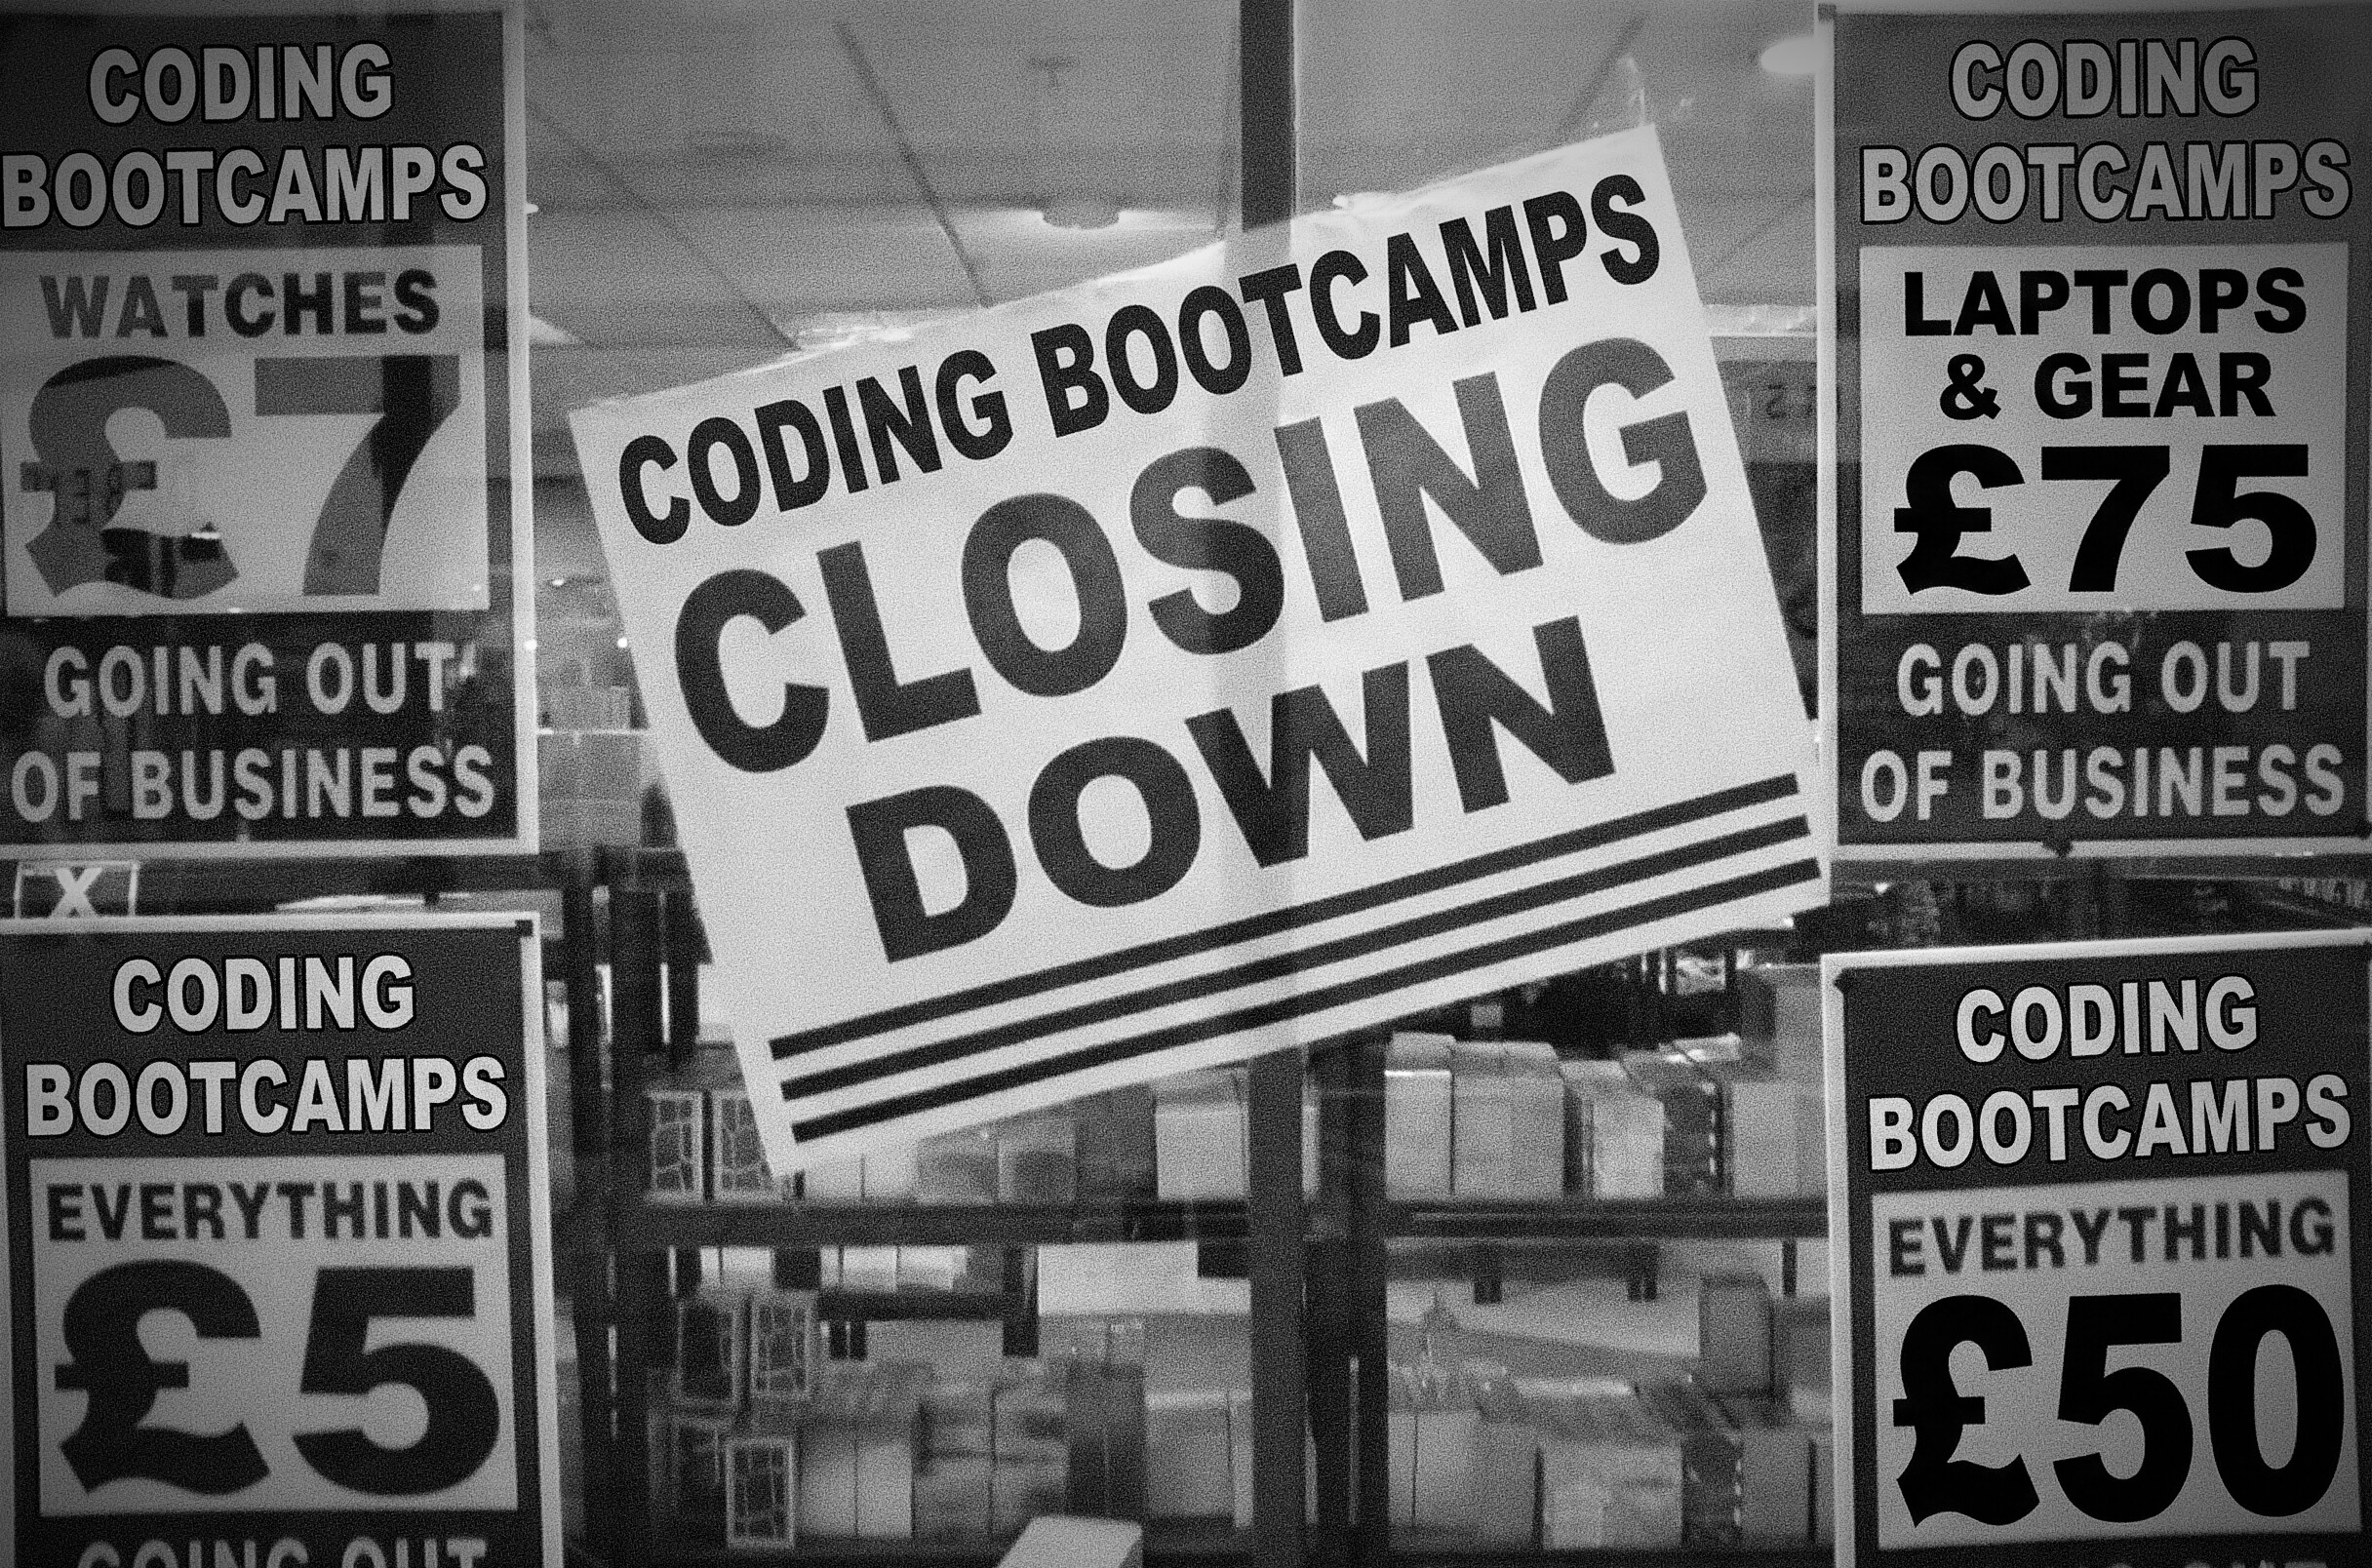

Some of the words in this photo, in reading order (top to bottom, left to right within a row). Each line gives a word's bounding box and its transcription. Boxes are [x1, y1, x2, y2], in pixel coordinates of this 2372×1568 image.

[91, 43, 392, 123] CODING
[1952, 40, 2255, 118] CODING
[3, 144, 487, 227] BOOTCAMPS
[1863, 143, 2348, 222] BOOTCAMPS
[39, 268, 440, 338] WATCHES
[1904, 266, 2308, 336] LAPTOPS
[618, 350, 1013, 545] CODING
[1031, 174, 1660, 438] BOOTCAMPS
[1939, 353, 2001, 421] &
[2034, 352, 2276, 420] GEAR
[20, 355, 460, 600] £7
[675, 337, 1708, 773] CLOSING
[1894, 443, 2317, 596] £75
[44, 642, 278, 719] GOING
[306, 641, 455, 715] OUT
[1896, 641, 2130, 717] GOING
[2160, 641, 2310, 714] OUT
[11, 751, 101, 823] OF
[132, 744, 495, 820] BUSINESS
[846, 616, 1615, 963] DOWN
[1860, 750, 1952, 823] OF
[1981, 744, 2344, 821] BUSINESS
[113, 955, 414, 1033] CODING
[1957, 976, 2257, 1063] CODING
[27, 1056, 507, 1136] BOOTCAMPS
[1869, 1075, 2350, 1170] BOOTCAMPS
[46, 1179, 493, 1243] EVERYTHING
[1889, 1196, 2336, 1277] EVERYTHING
[53, 1259, 499, 1498] £5
[1893, 1283, 2346, 1528] £50
